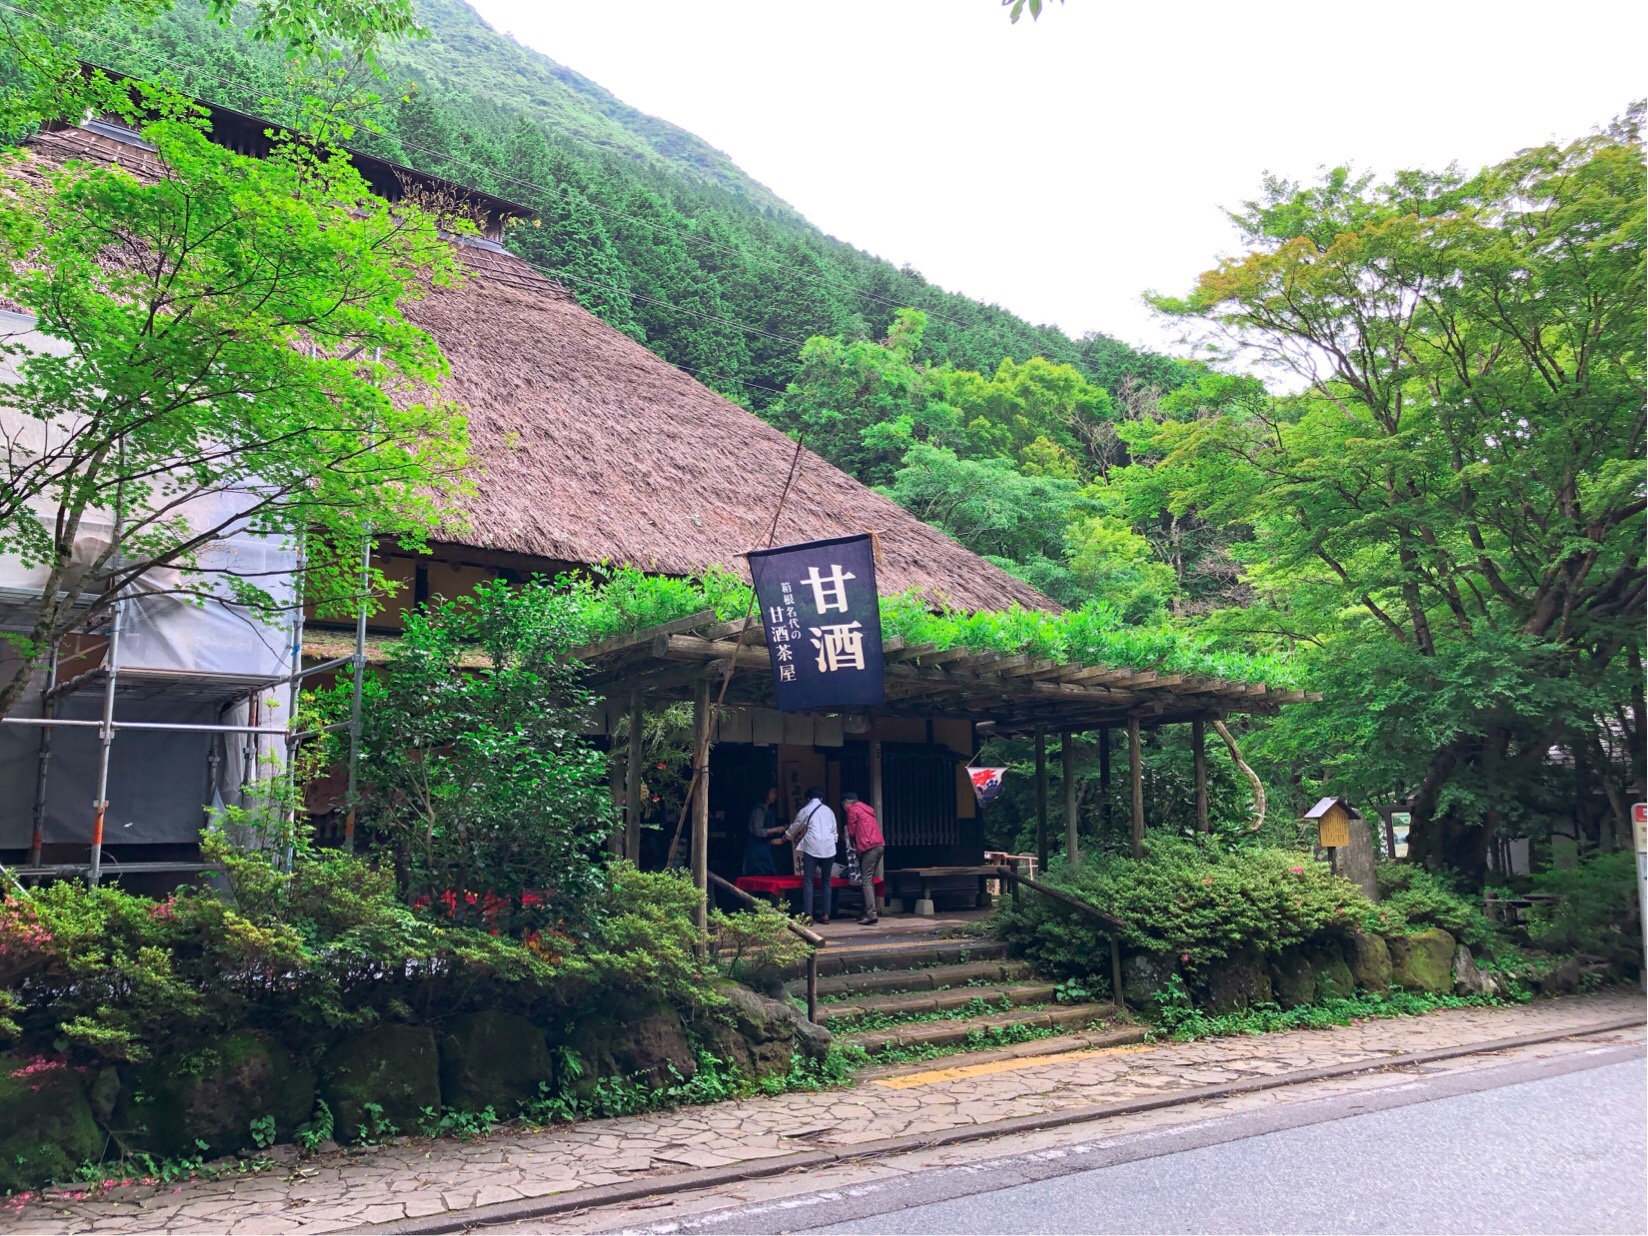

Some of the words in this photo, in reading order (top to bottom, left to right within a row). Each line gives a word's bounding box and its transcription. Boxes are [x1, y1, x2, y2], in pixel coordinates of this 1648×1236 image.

[768, 606, 797, 683] 甘酒茶屋
[781, 582, 801, 640] 箱根名代の
[800, 564, 865, 673] 甘酒
